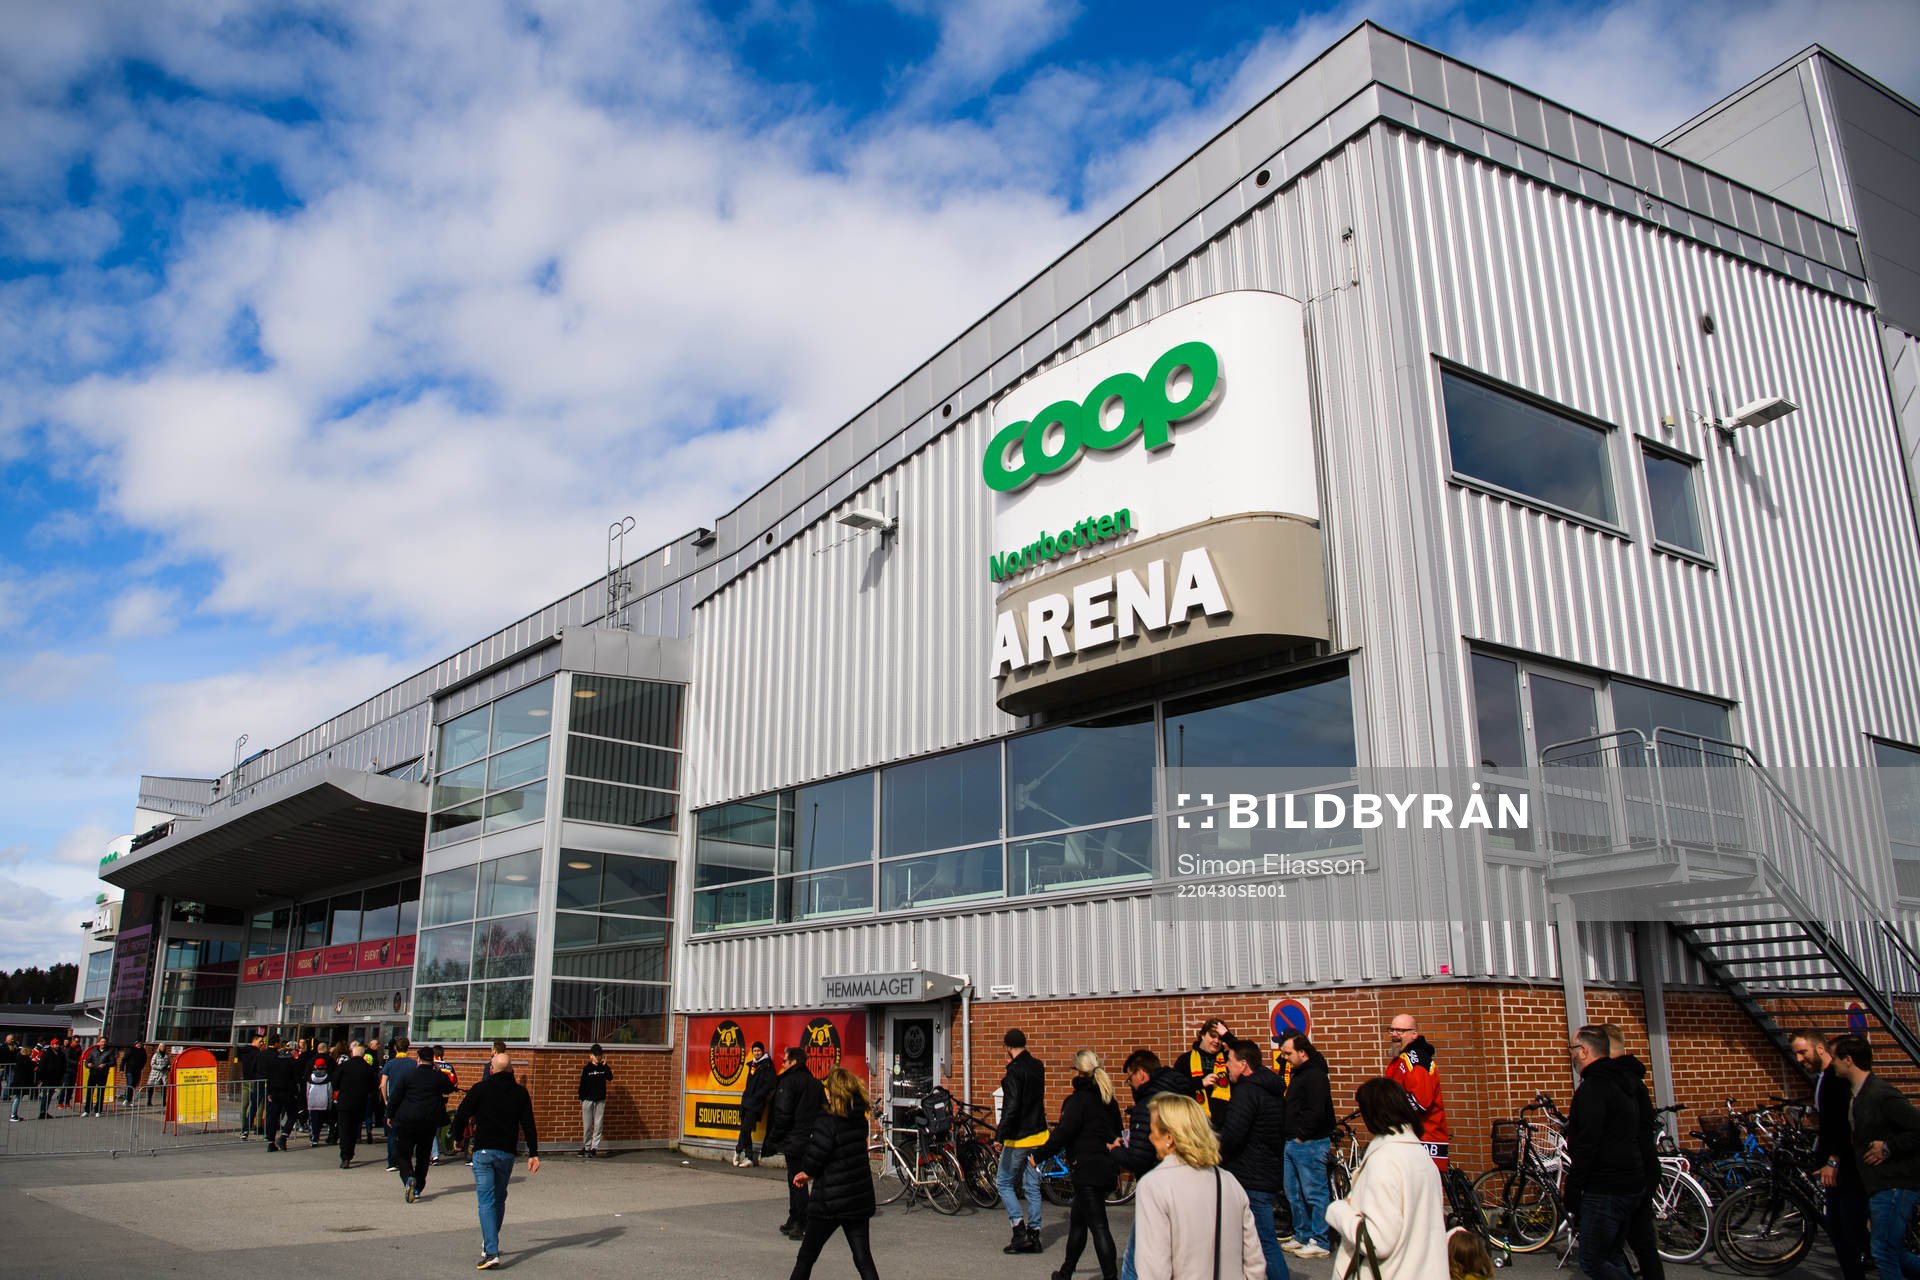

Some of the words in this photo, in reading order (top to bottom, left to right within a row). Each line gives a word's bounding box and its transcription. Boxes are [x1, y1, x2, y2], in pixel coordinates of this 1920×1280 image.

[983, 341, 1221, 492] coop
[990, 507, 1135, 582] Norrbotten
[990, 547, 1230, 679] ARENA
[826, 977, 914, 998] HEMMALAGET
